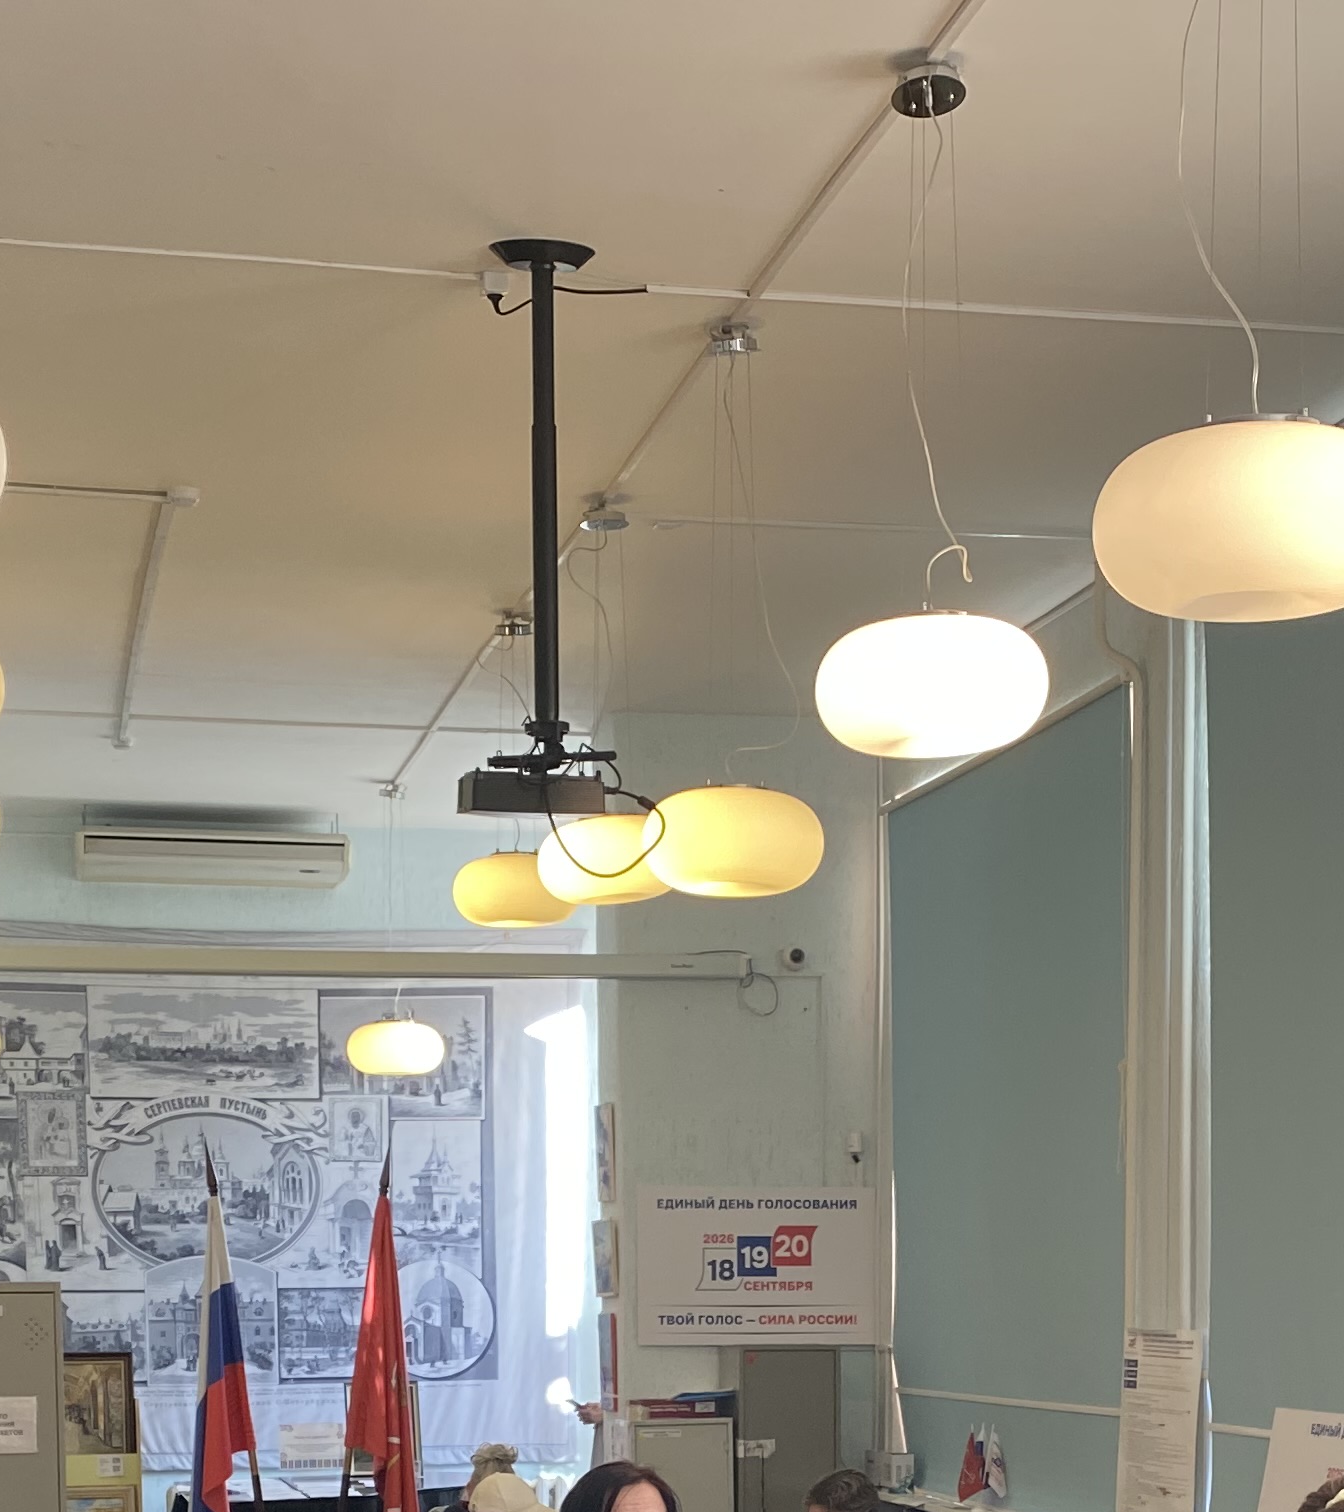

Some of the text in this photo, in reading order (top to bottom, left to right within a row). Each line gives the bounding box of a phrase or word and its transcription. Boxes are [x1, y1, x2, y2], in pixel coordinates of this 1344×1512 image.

[219, 1097, 268, 1121] ПУСТЫНЬ
[657, 1196, 857, 1211] ЕДИНЫЙ ДЕНЬ ГОЛОСОВАНИЯ
[703, 1234, 734, 1244] 2026
[707, 1234, 809, 1281] 18 19 20
[743, 1281, 813, 1291] СЕНТЯБРЯ
[658, 1313, 695, 1325] ТВОЙ
[698, 1315, 743, 1325] ГОЛОС
[758, 1315, 795, 1325] СИЛА
[798, 1315, 857, 1325] РОССИИ!
[1310, 1422, 1342, 1437] ЕДИНЫЙ
